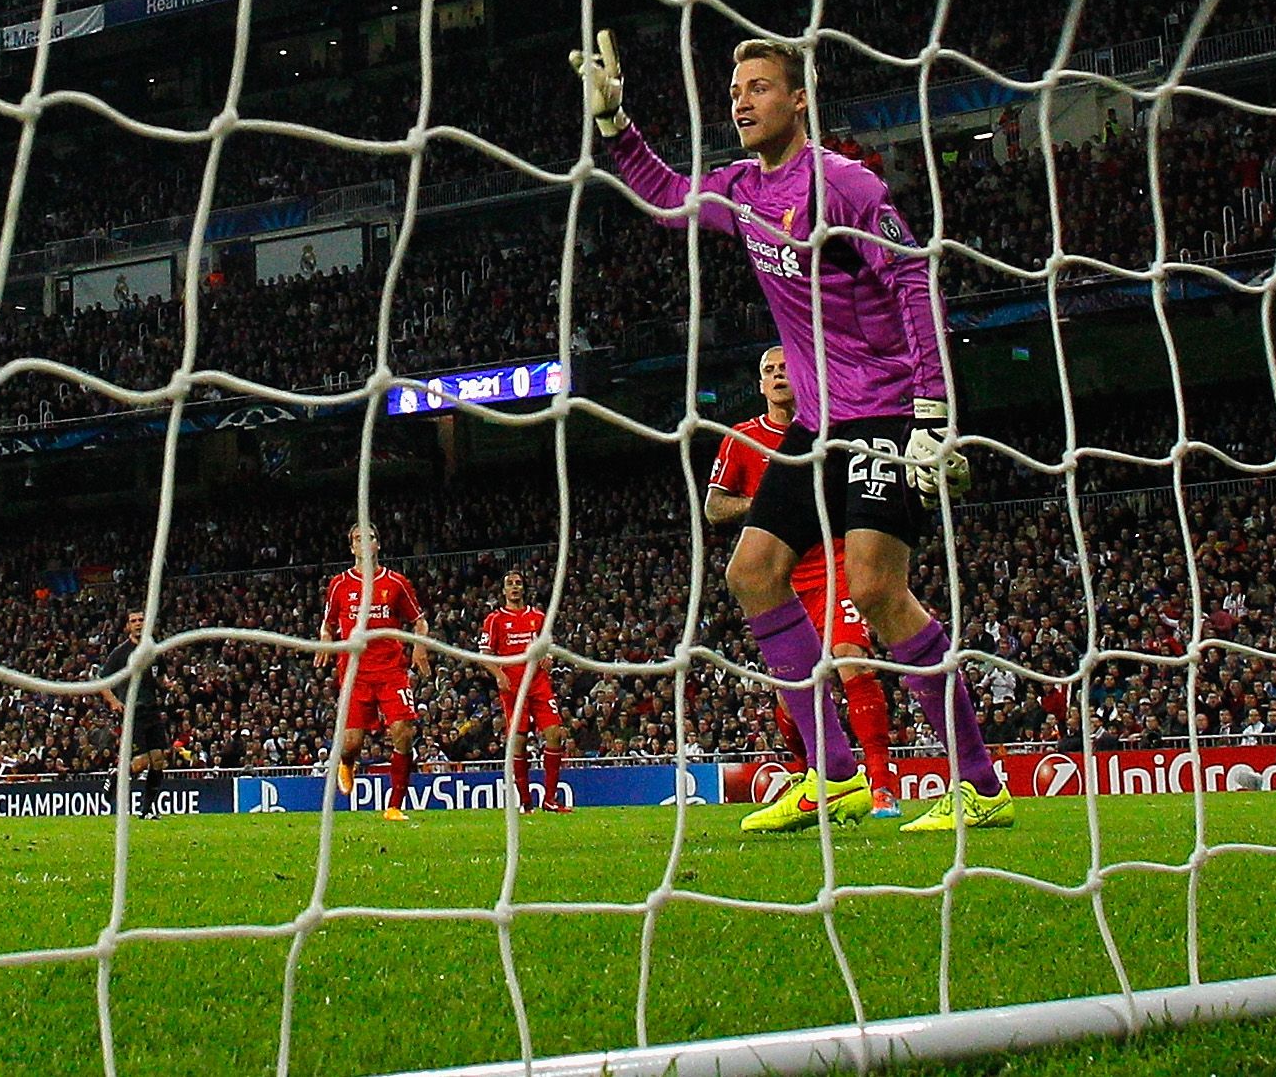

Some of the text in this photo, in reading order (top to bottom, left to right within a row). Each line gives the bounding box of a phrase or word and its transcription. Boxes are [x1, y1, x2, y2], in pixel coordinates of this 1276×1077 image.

[427, 378, 443, 409] 0
[513, 366, 531, 398] 0
[848, 437, 899, 484] 22
